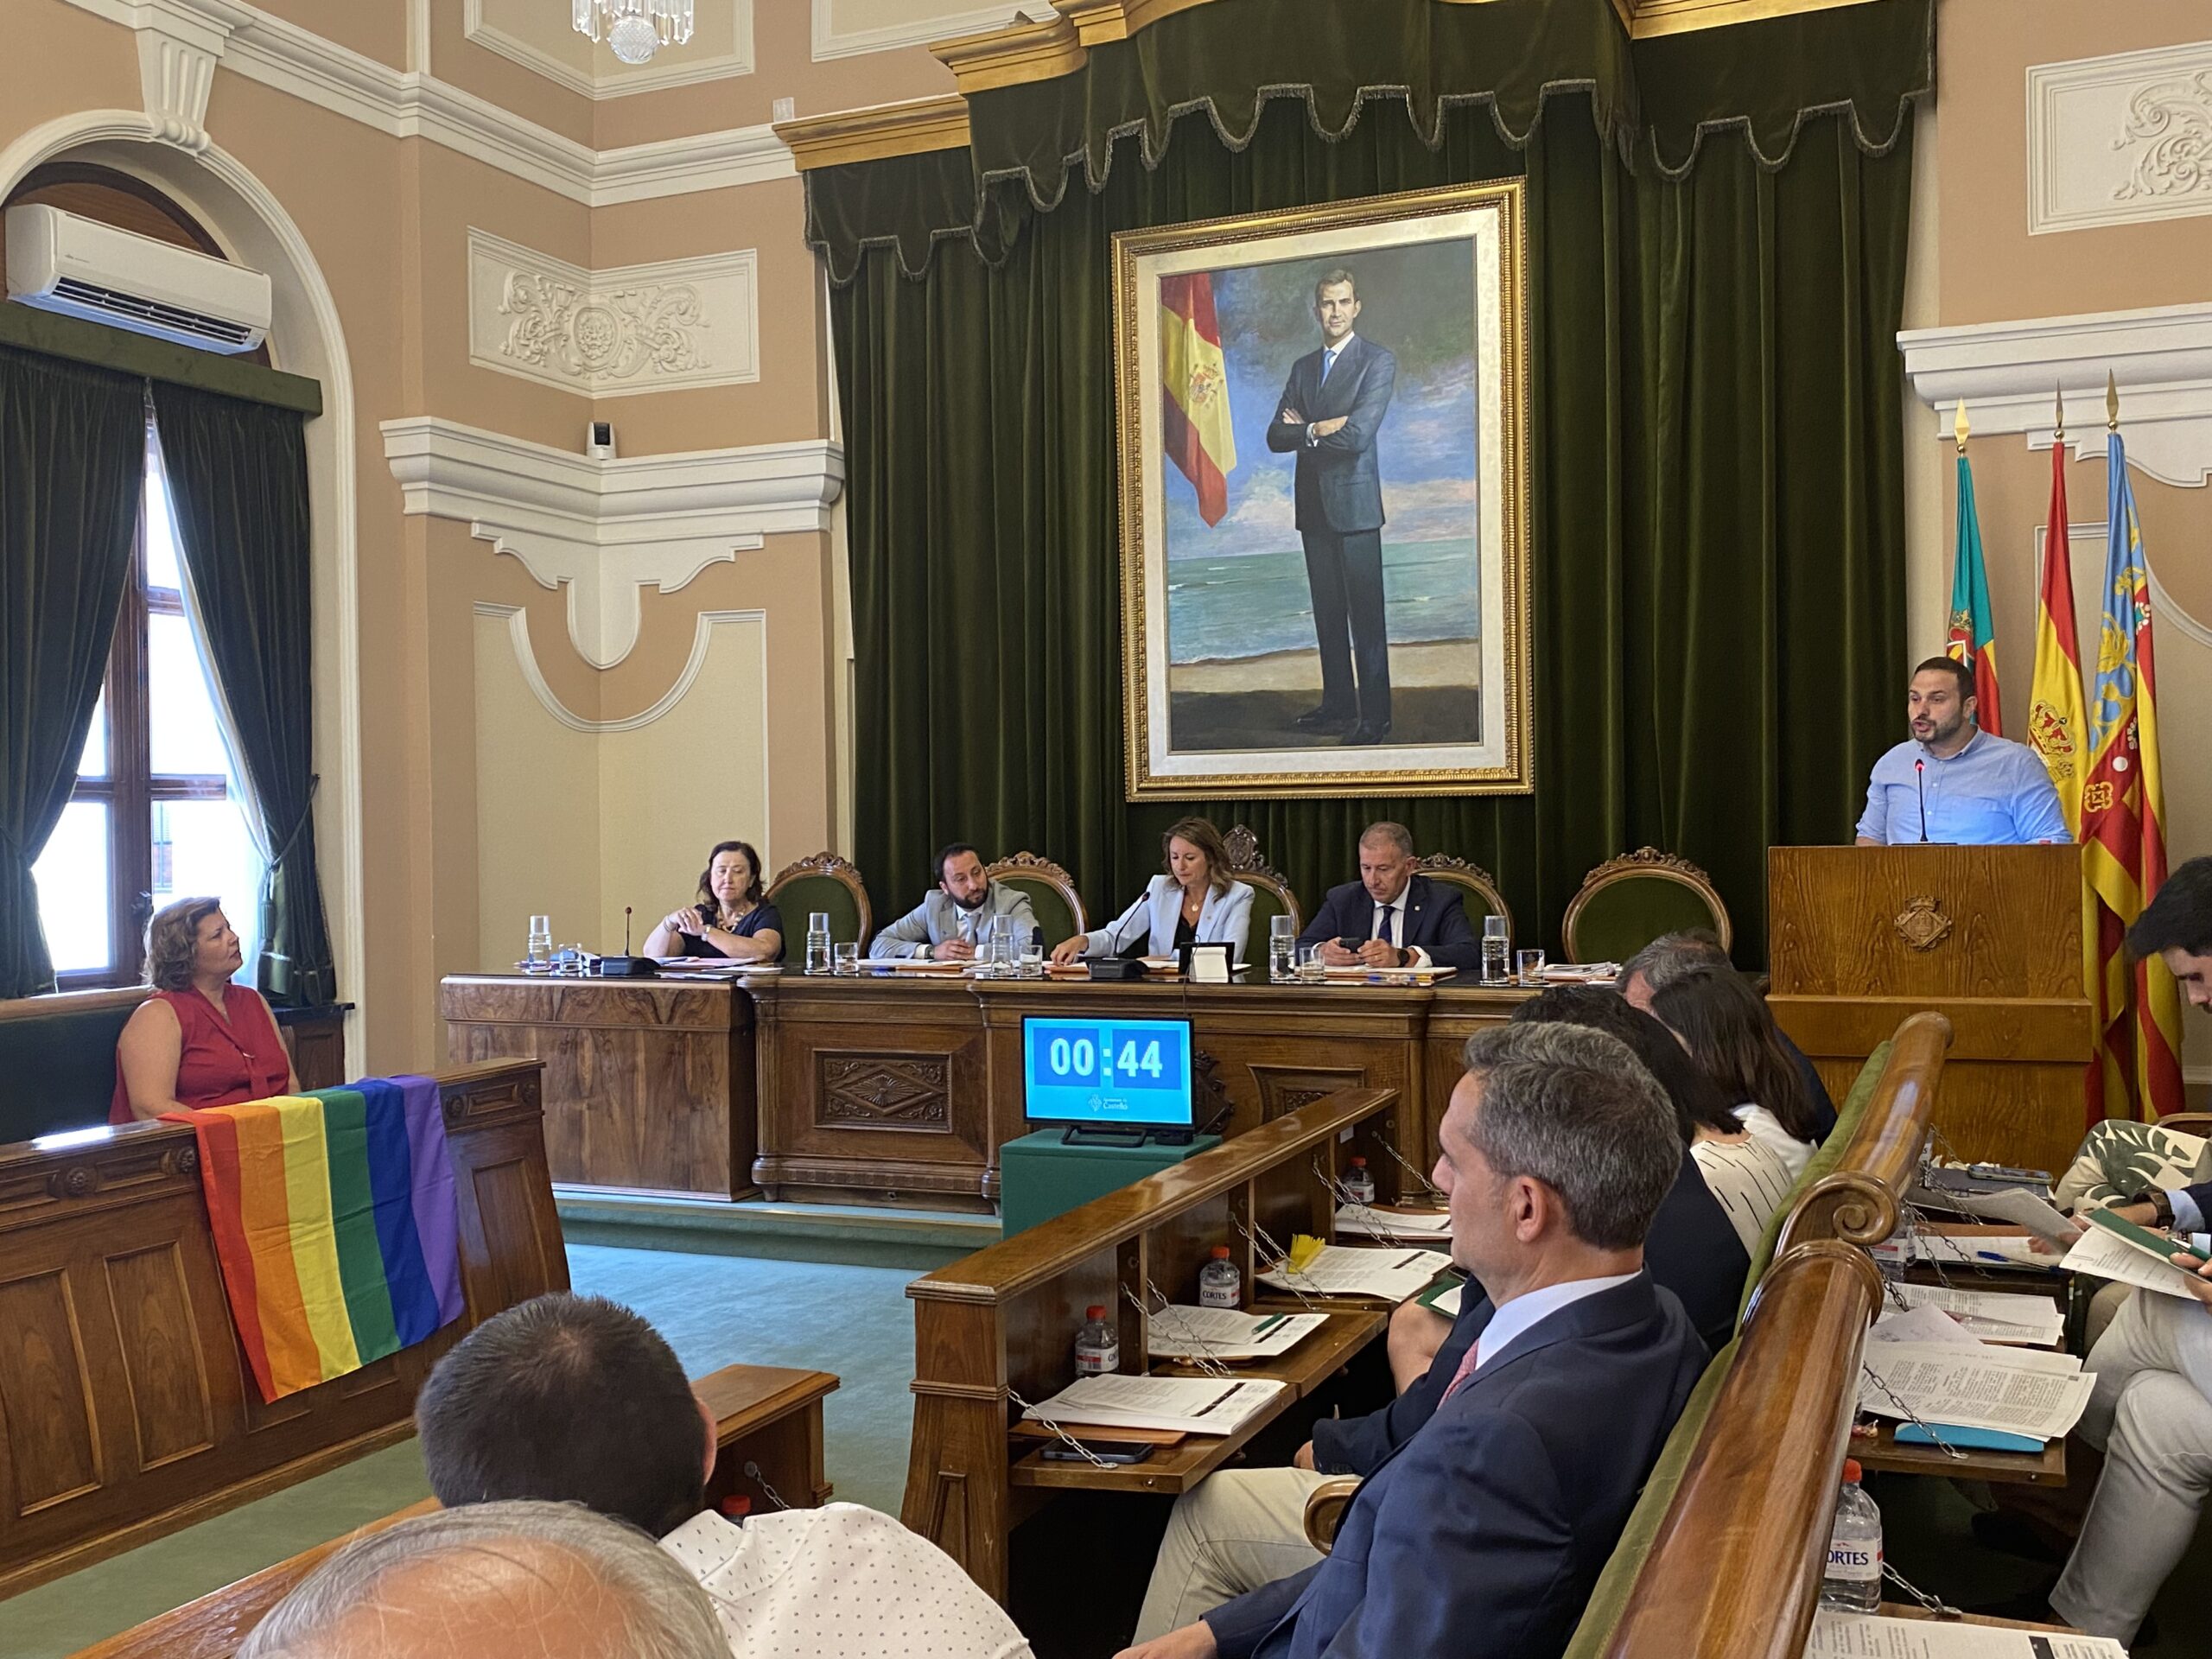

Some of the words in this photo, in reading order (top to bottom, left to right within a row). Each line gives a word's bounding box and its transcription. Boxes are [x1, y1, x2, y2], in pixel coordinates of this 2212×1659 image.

[1050, 1038, 1163, 1078] 00:44
[1202, 1290, 1227, 1300] CORTES
[1827, 1550, 1869, 1566] ORTES
